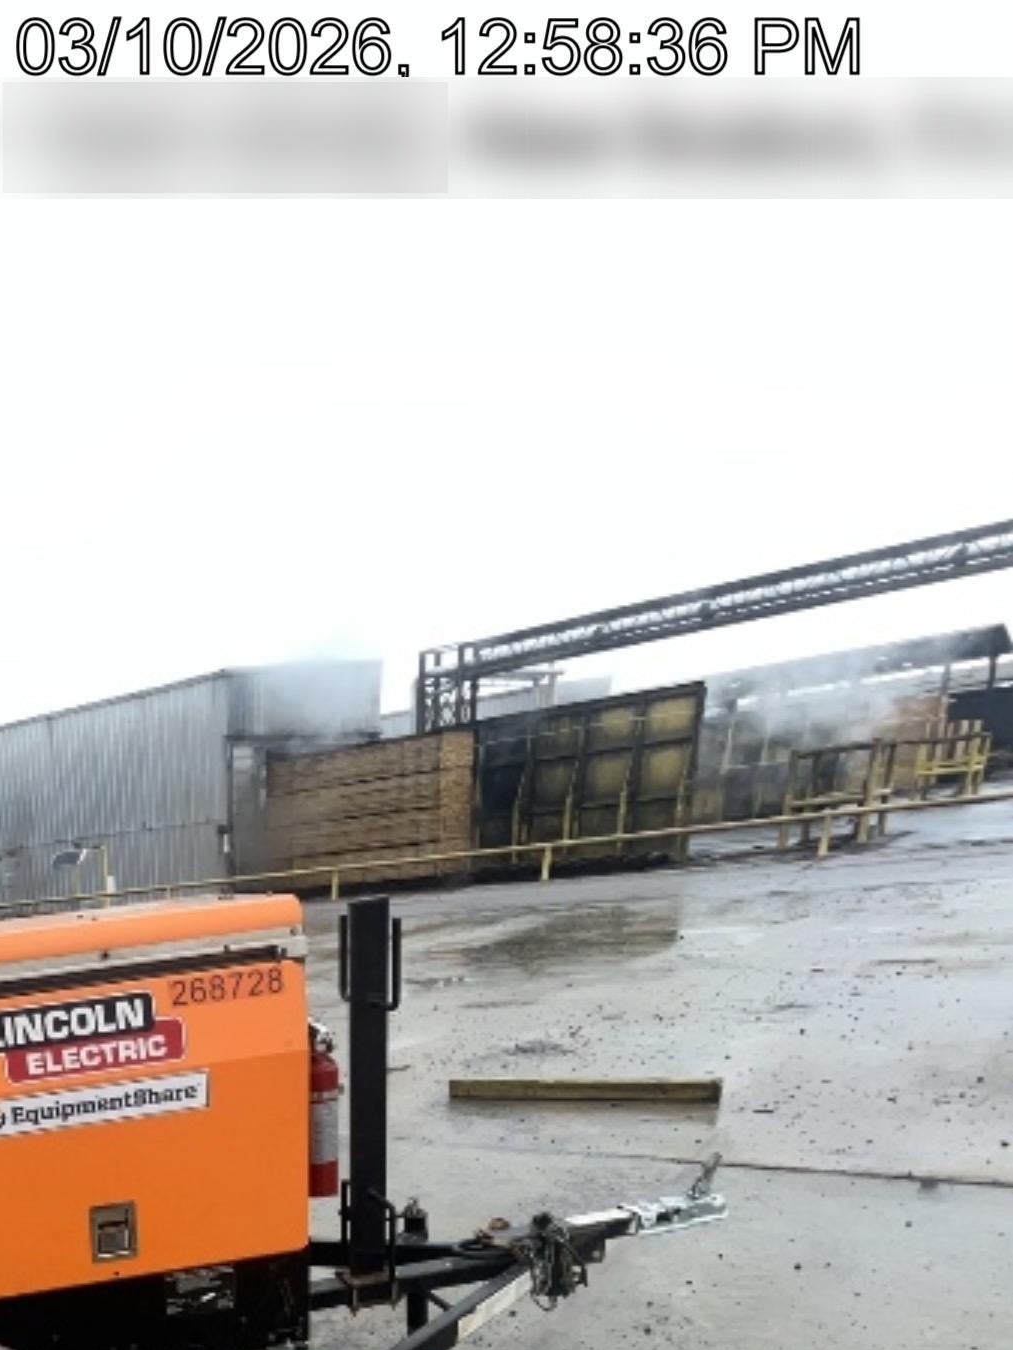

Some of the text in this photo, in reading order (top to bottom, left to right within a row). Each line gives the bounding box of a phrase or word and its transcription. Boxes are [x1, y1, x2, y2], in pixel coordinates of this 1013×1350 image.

[171, 967, 284, 1006] 268728
[26, 1035, 168, 1076] ELECTRIC
[11, 1084, 199, 1125] EquipmentShare
